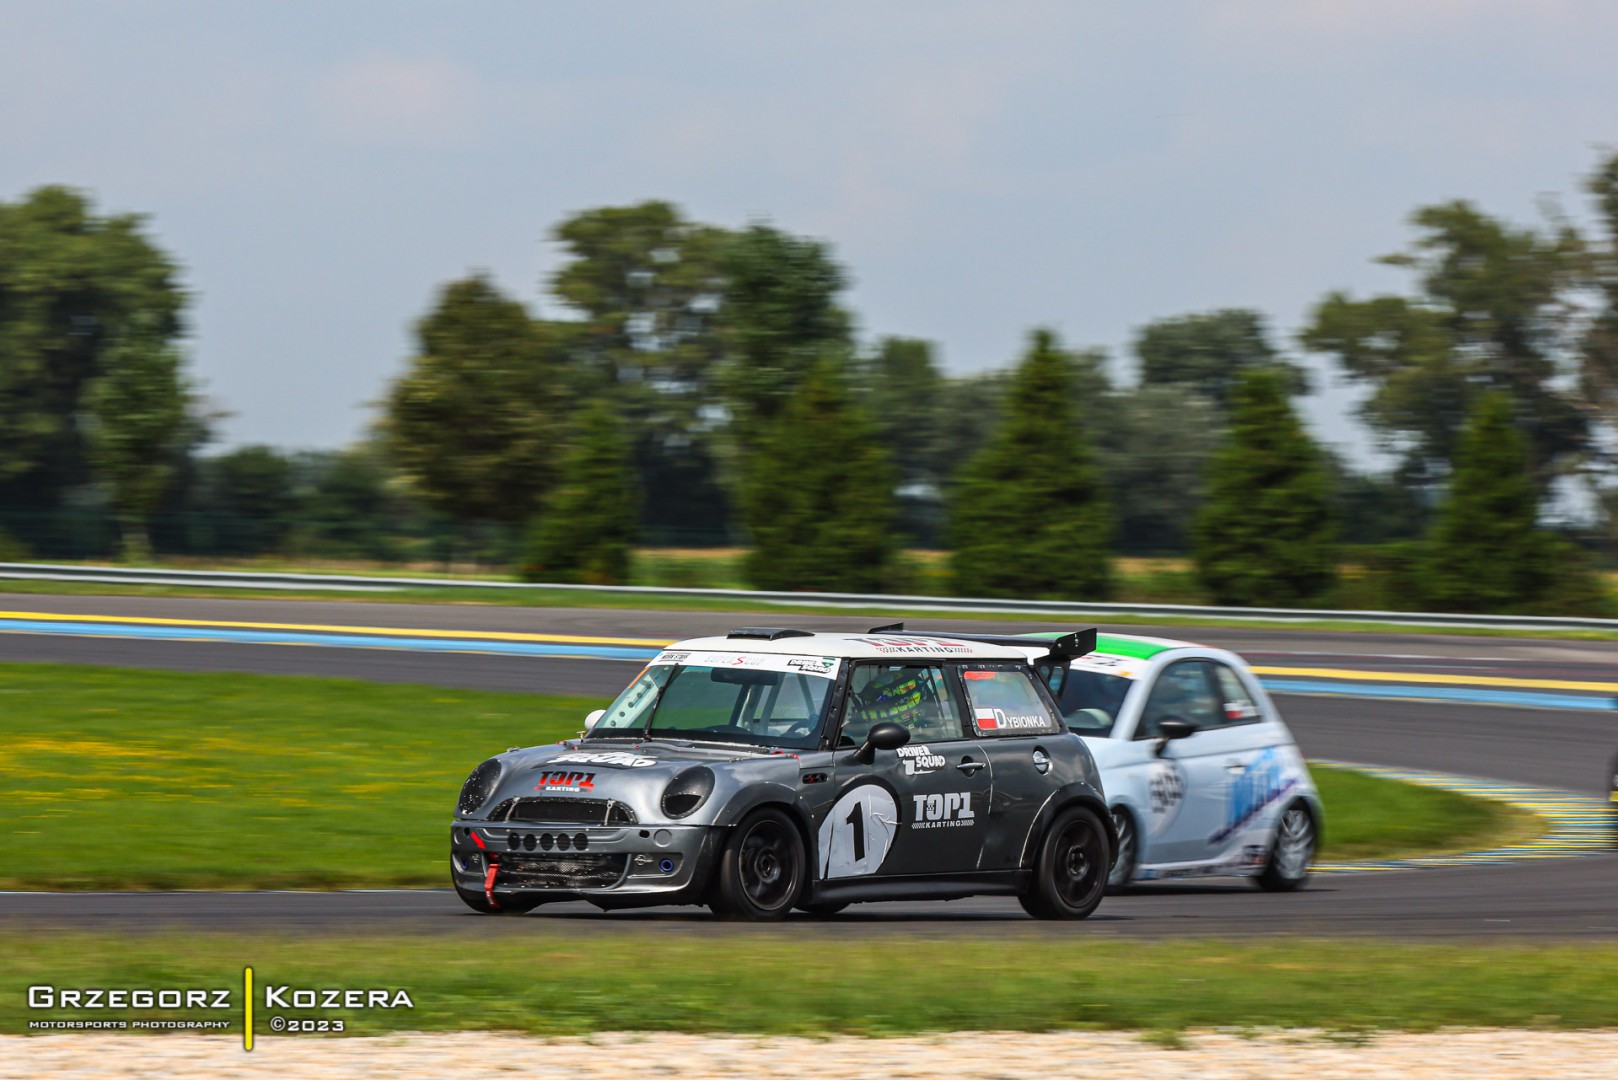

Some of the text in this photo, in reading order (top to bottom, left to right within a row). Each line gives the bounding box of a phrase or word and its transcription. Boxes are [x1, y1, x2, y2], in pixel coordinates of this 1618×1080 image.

[993, 708, 1047, 729] DYBIONKA
[896, 745, 931, 758] DRIVER
[915, 755, 946, 768] SQUAD
[538, 770, 597, 788] TOP1
[913, 791, 975, 822] TOP1
[846, 801, 866, 863] 1
[925, 820, 962, 829] KARTING
